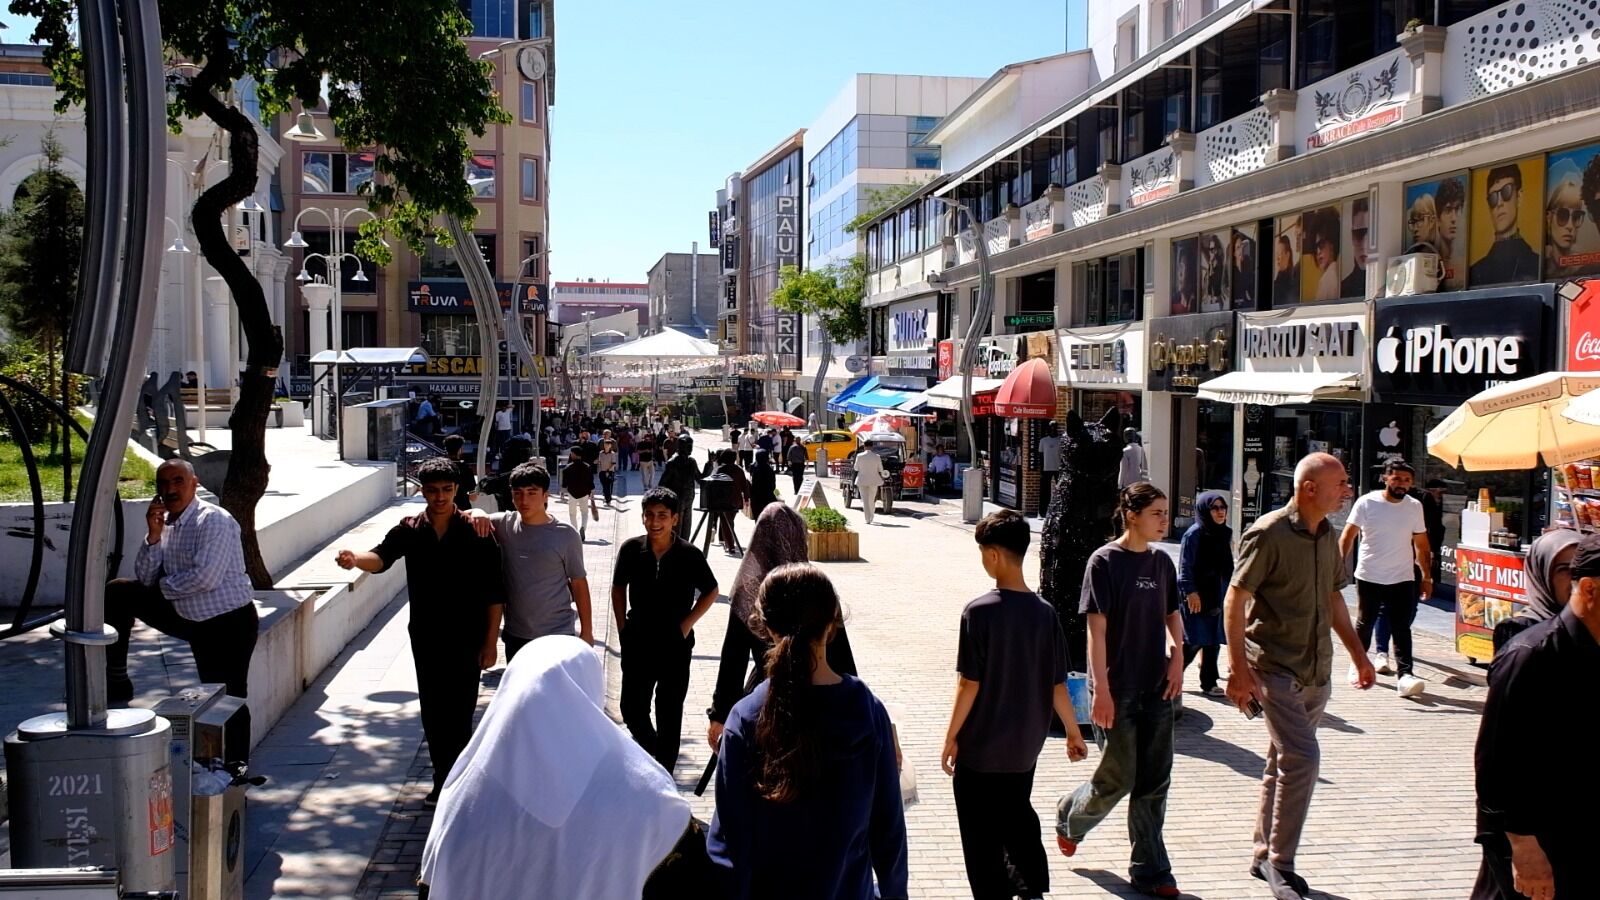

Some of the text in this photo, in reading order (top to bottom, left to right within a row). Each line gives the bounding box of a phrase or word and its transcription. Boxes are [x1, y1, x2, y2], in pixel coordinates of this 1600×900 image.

[1311, 123, 1354, 147] TERRACE
[411, 295, 458, 307] TRUVA
[522, 303, 545, 311] TRUVA
[1241, 322, 1358, 358] URARTU SAAT
[1405, 324, 1519, 374] iPhone
[429, 384, 457, 393] HAKAN
[1219, 391, 1289, 405] URARTU SAAT
[1469, 558, 1526, 589] SÜT MISI
[49, 774, 103, 796] 2021
[60, 807, 90, 868] YESİ
